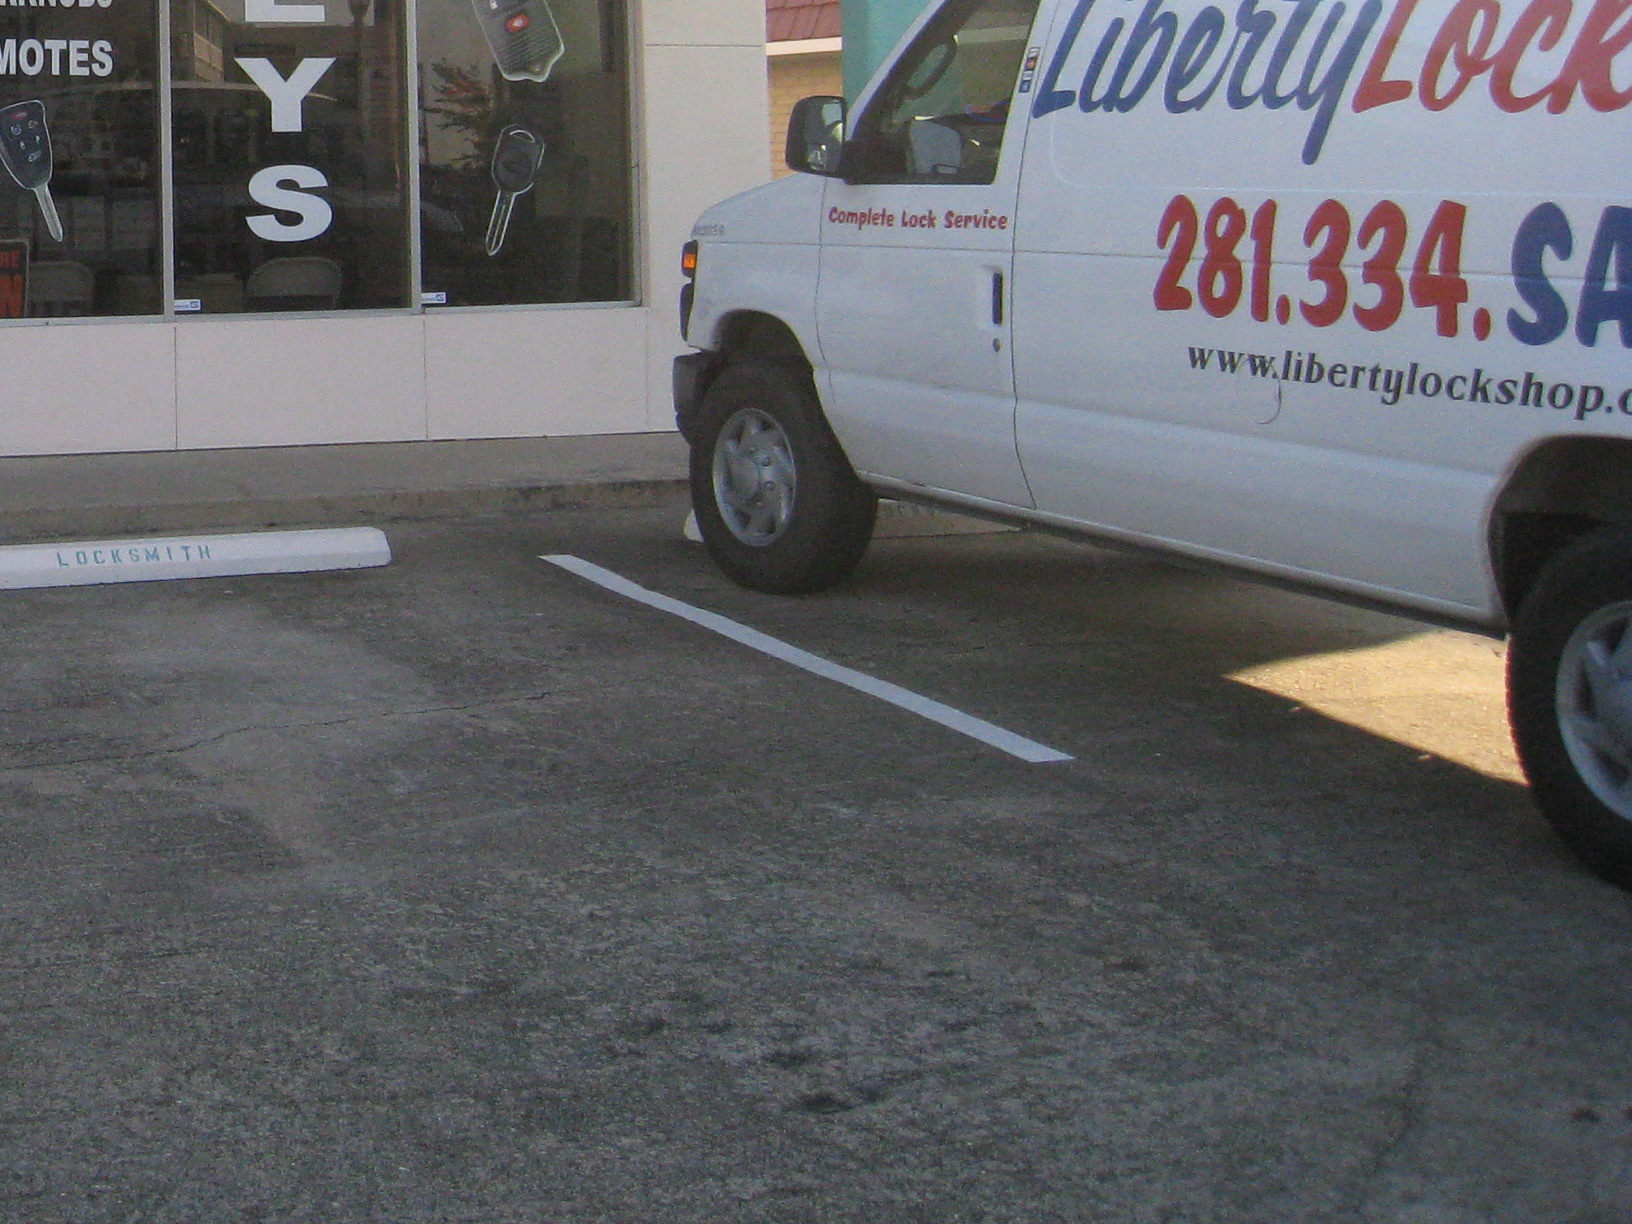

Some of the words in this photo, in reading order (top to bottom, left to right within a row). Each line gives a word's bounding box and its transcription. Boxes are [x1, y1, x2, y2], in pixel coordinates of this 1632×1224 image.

[828, 206, 895, 231] Complete
[901, 210, 937, 229] Lock
[944, 208, 1009, 230] Service
[57, 545, 212, 568] LOCKSMITH
